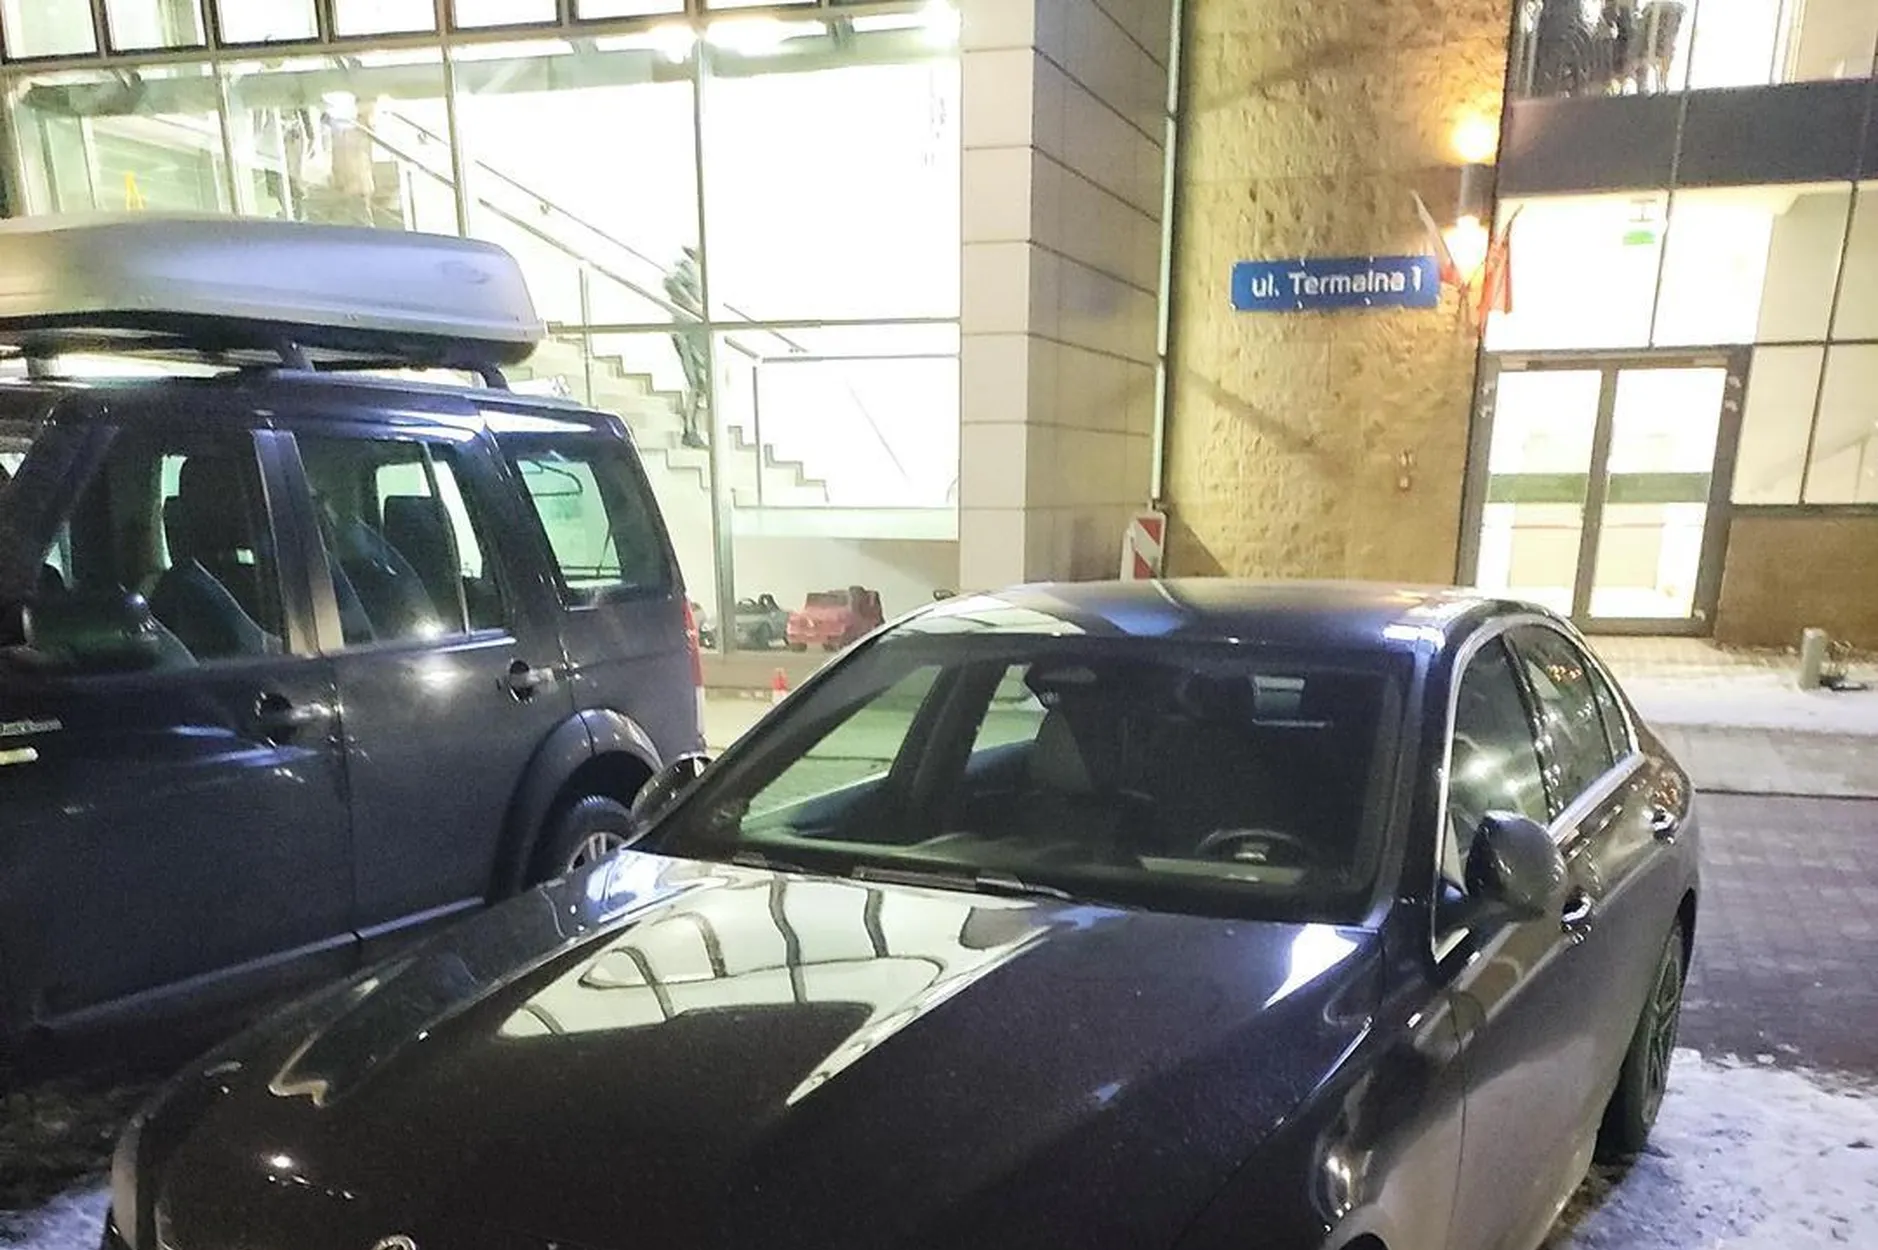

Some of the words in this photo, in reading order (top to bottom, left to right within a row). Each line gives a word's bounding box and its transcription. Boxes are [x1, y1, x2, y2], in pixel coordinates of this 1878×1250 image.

[1251, 272, 1280, 298] ul.
[1288, 269, 1406, 295] Termalna
[1411, 265, 1423, 293] 1
